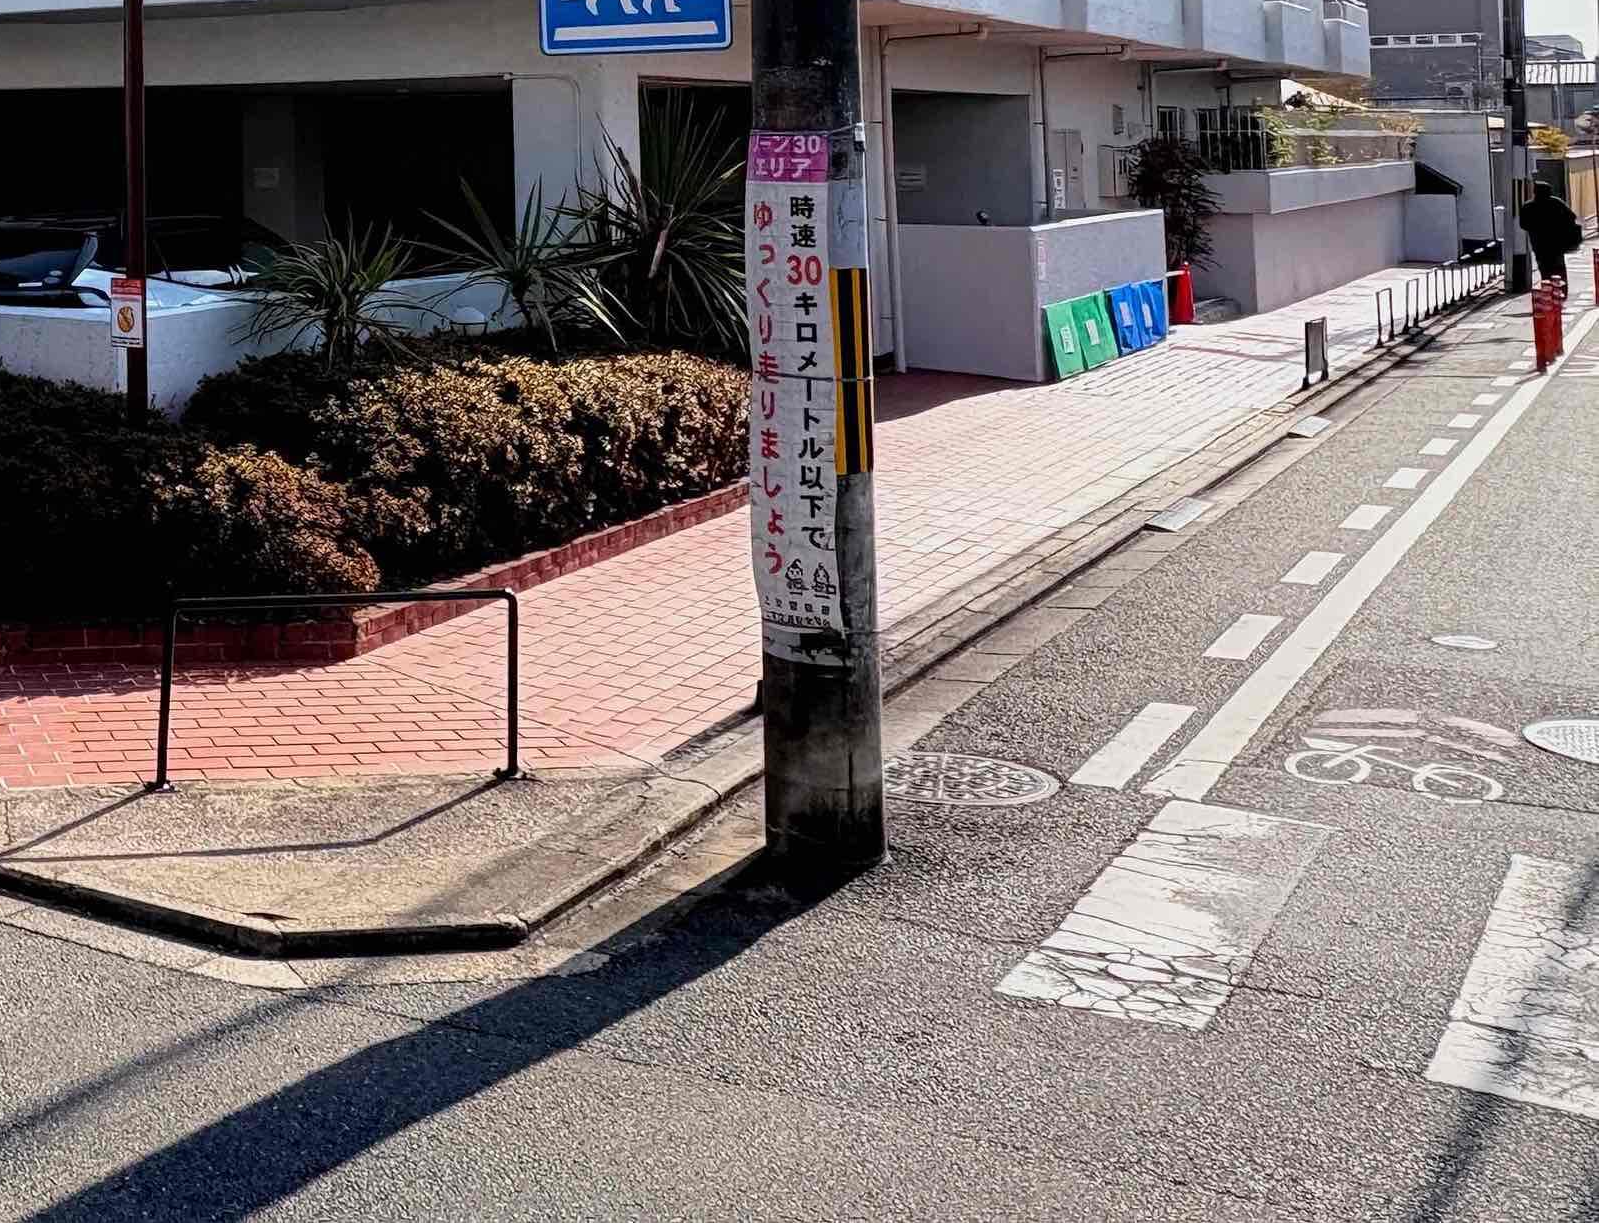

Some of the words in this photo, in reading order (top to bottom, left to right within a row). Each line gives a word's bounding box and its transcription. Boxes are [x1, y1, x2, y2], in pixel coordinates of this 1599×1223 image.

[756, 158, 811, 177] エリア
[753, 201, 785, 575] ゆっくり走りましょう
[786, 195, 827, 551] 時速30キロメートル以下で
